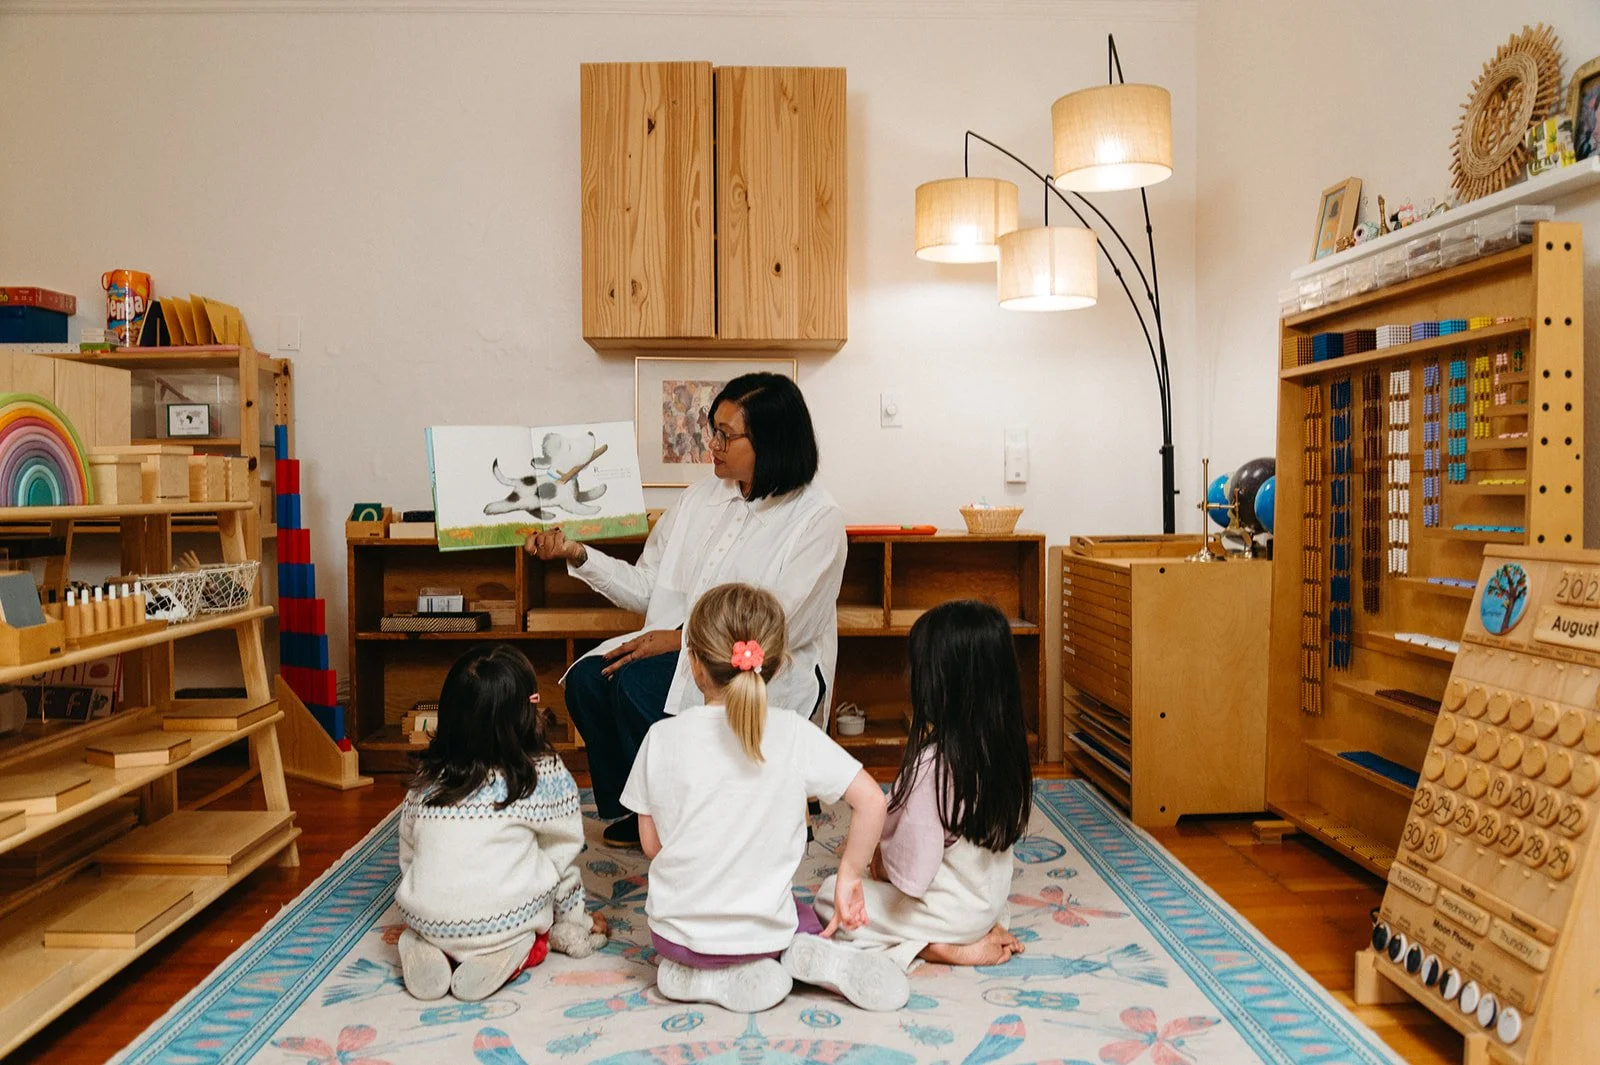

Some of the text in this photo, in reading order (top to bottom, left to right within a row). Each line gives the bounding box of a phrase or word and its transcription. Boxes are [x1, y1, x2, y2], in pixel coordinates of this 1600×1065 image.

[107, 295, 144, 321] Jenga
[1556, 577, 1599, 602] 202
[1551, 615, 1600, 638] August
[1490, 778, 1582, 832] 19 20 21 22
[1403, 823, 1440, 856] 30 31
[1414, 788, 1570, 873] 23 24 25 26 27 28 29
[1397, 871, 1423, 894] Tuesday
